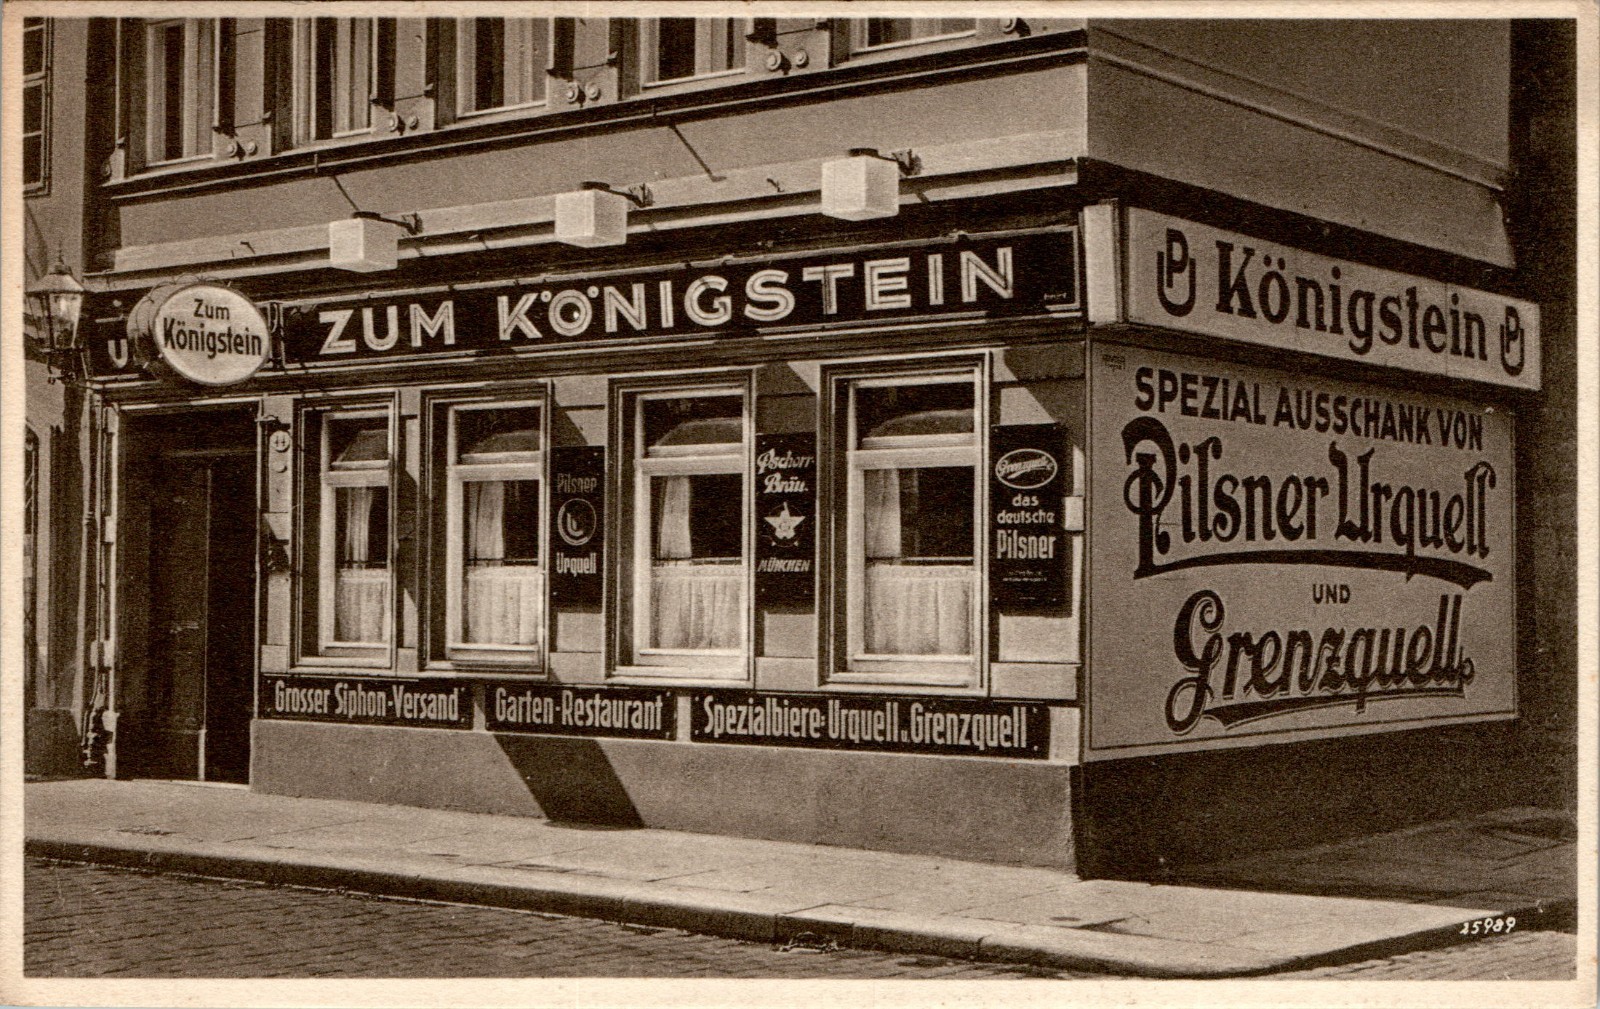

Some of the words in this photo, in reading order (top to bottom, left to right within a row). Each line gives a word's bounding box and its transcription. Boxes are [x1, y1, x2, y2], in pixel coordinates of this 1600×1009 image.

[193, 299, 230, 320] Zum
[318, 300, 456, 354] ZUM
[497, 246, 1014, 341] KÖNIGSTEIN
[1215, 240, 1487, 355] Königstein
[163, 318, 262, 360] Königstein
[1135, 366, 1266, 426] SPEZIAL
[1273, 390, 1430, 445] AUSSCHANK
[1439, 408, 1483, 451] VON
[557, 473, 597, 494] Pilsner
[1012, 493, 1039, 507] das
[1121, 416, 1330, 578] Pilsner
[1328, 441, 1496, 575] Urquell
[997, 509, 1055, 524] deutsche
[556, 552, 597, 577] Urquell
[757, 556, 811, 573] MÜNCHEN
[996, 529, 1056, 559] Pilsner
[1312, 583, 1351, 605] UND
[1165, 589, 1475, 735] Grenzquell
[275, 680, 330, 714] Grosser
[334, 682, 459, 721] Siphon-Versand
[496, 687, 663, 731] Garten-Restaurant
[828, 699, 899, 743] Urquell
[910, 702, 1027, 750] Grenzquell
